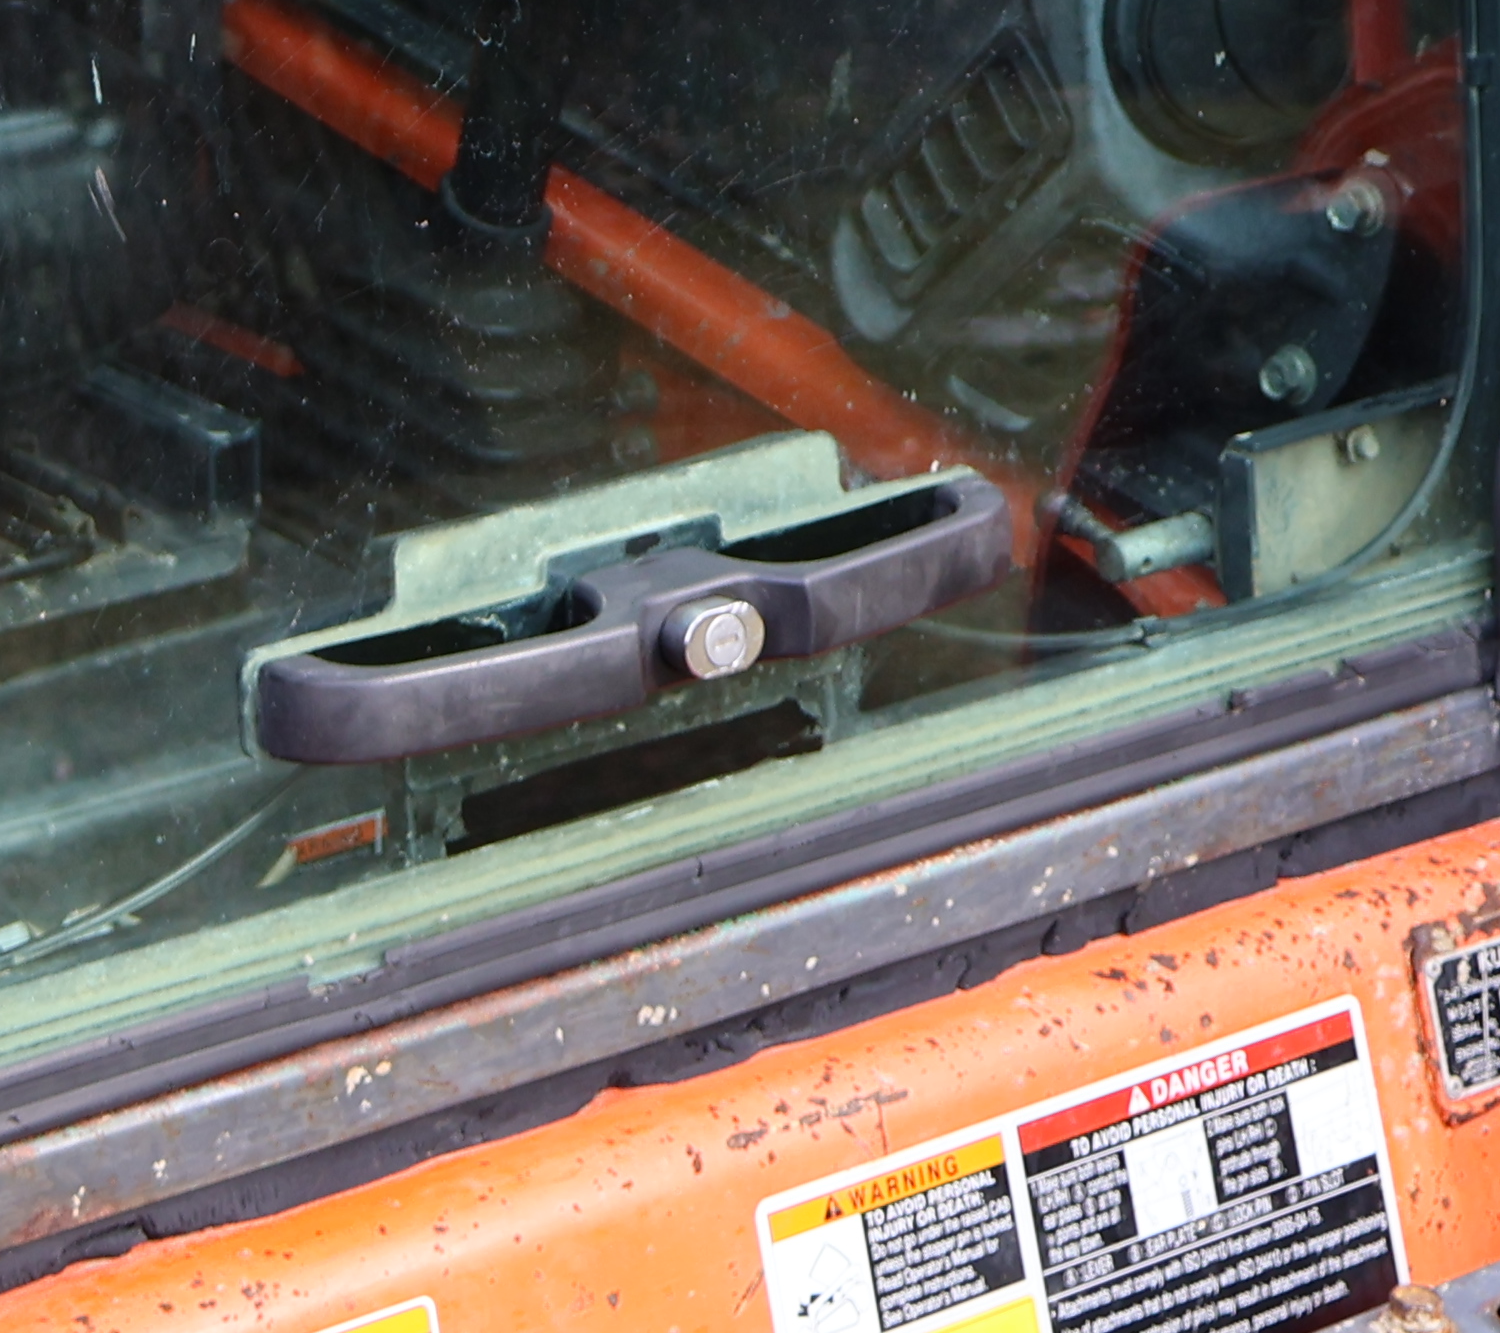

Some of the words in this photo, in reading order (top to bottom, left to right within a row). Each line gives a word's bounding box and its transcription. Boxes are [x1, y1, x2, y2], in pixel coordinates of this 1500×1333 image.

[1149, 1048, 1249, 1105] DANGER
[1069, 1133, 1091, 1159] TO
[1089, 1119, 1133, 1152] AVOID
[1130, 1095, 1200, 1137] PERSONAL
[1198, 1078, 1247, 1113] INJURY
[1245, 1071, 1267, 1096] OR
[847, 1153, 959, 1211] WARNING
[864, 1206, 886, 1229] TO
[884, 1191, 927, 1222] AVOID
[925, 1166, 996, 1207] PERSONAL
[867, 1213, 916, 1245] INJURY
[915, 1205, 937, 1228] OR
[870, 1240, 887, 1262] Do
[987, 1193, 1012, 1218] CAB
